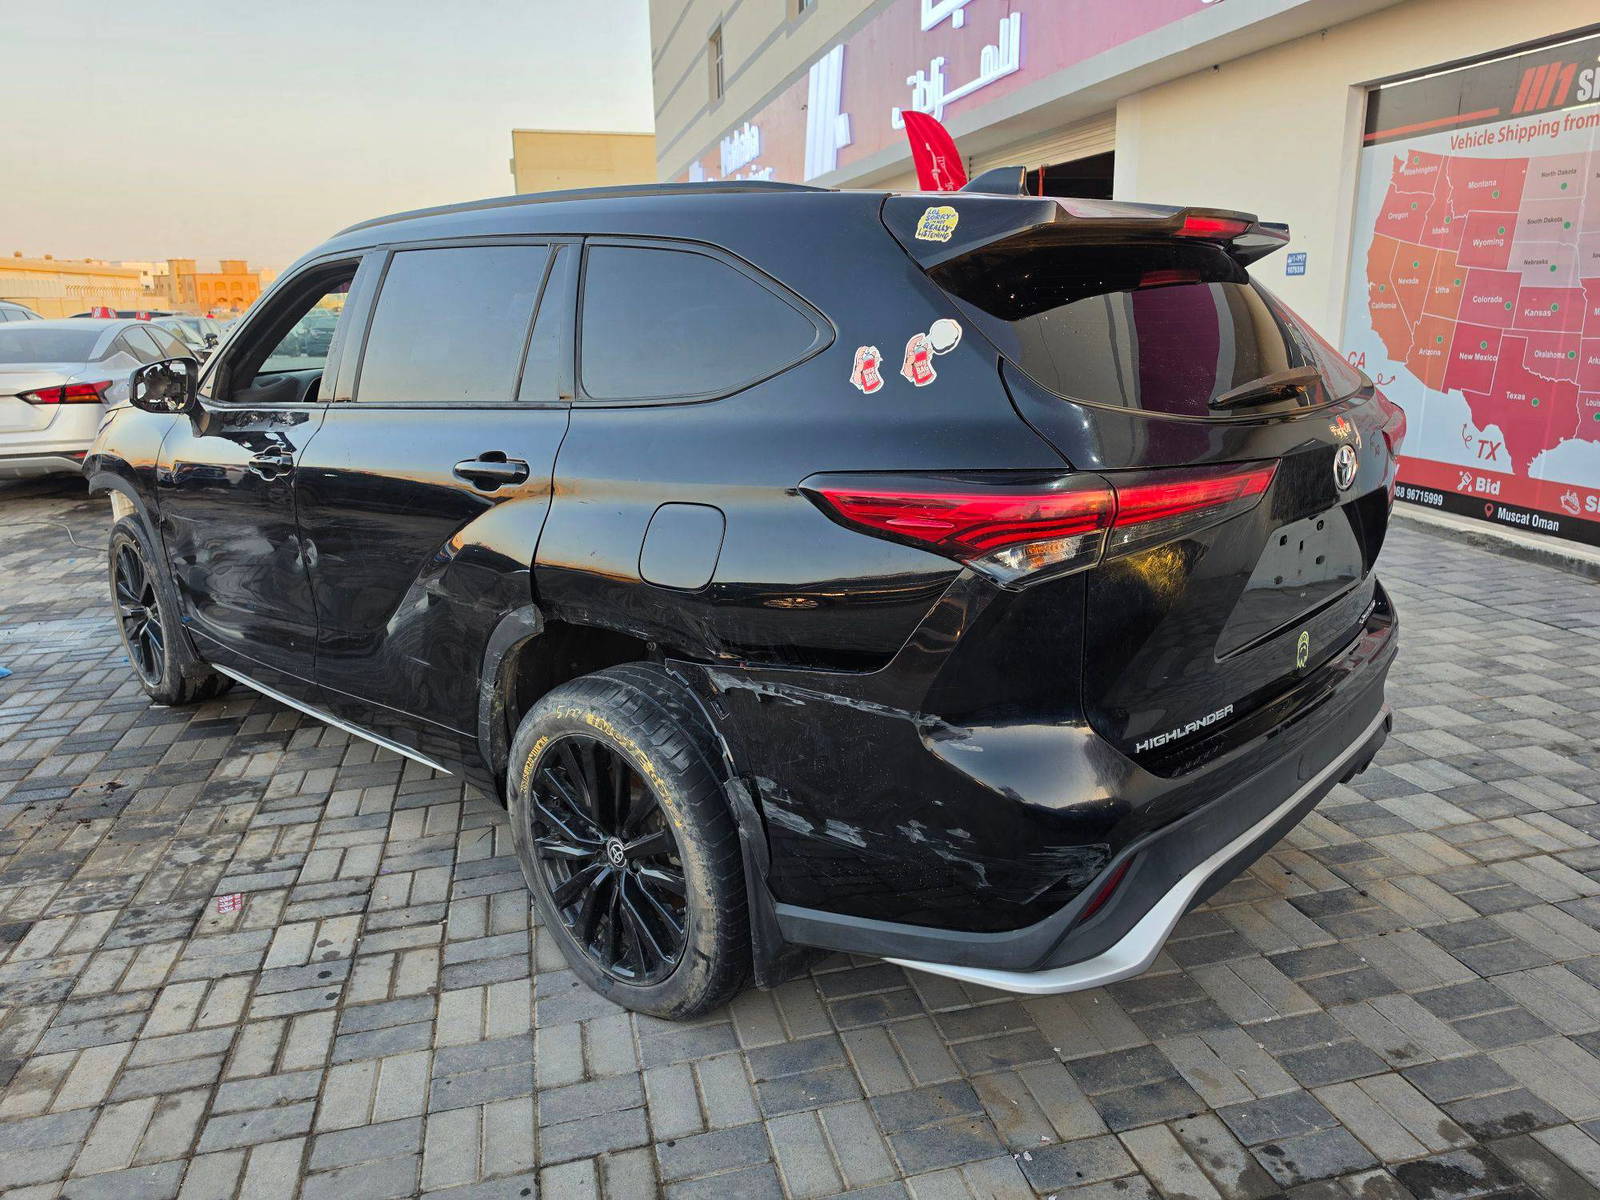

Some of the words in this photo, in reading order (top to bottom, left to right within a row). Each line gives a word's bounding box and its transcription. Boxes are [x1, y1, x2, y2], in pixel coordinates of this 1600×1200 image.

[1450, 129, 1495, 151] Vehicle
[1498, 119, 1560, 143] Shipping
[1564, 113, 1600, 132] from
[1557, 168, 1577, 176] Dakota
[1468, 180, 1497, 189] Montana
[1388, 212, 1409, 221] Oregon
[1543, 216, 1563, 224] Dakota
[1473, 237, 1504, 248] Wyoming
[1398, 277, 1420, 285] Nevada
[1472, 295, 1503, 303] Colorado
[1524, 309, 1552, 317] Kansas
[1419, 348, 1441, 356] Arizona
[1459, 352, 1473, 360] New
[1474, 353, 1498, 362] Mexico
[1506, 391, 1526, 401] Texas
[1478, 440, 1502, 461] TX
[1475, 476, 1501, 496] Bid
[1406, 487, 1443, 506] 96715999
[1498, 507, 1530, 526] Muscat
[1532, 514, 1560, 531] Oman
[1135, 703, 1234, 754] HIGHLANDER
